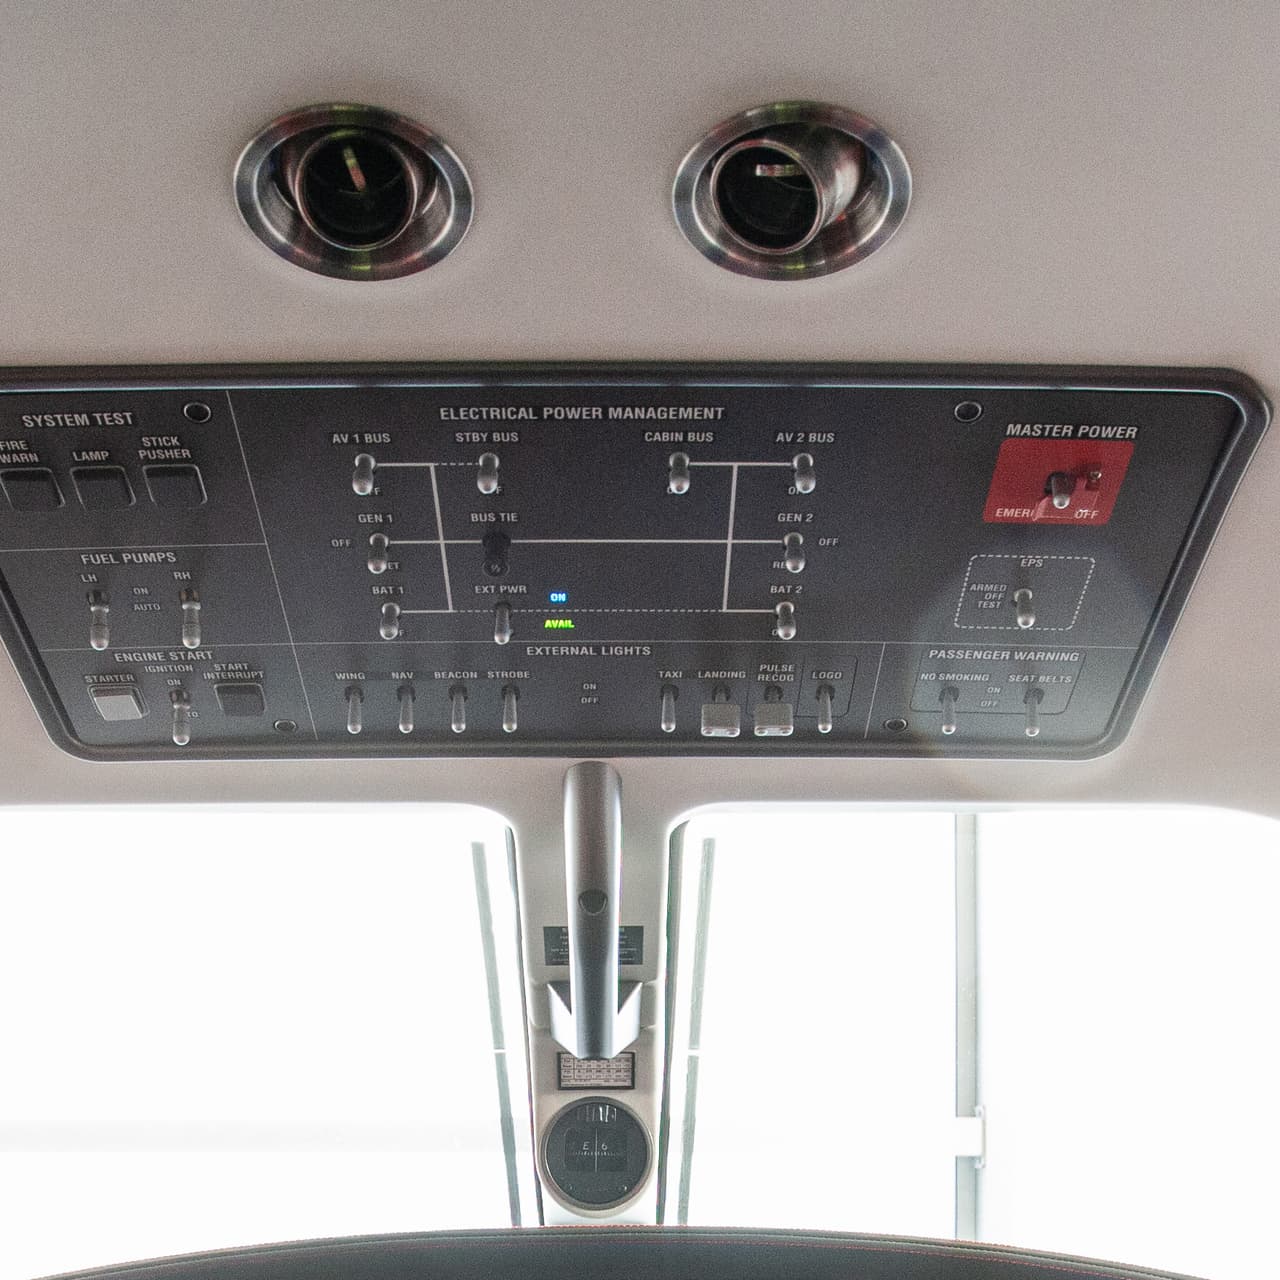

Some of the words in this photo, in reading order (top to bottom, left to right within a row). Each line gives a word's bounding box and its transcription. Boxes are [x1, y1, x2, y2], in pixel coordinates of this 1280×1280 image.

[440, 408, 538, 420] ELECTRICAL
[543, 407, 603, 420] POWER
[609, 407, 725, 420] MANAGEMENT
[22, 413, 90, 428] SYSTEM
[93, 412, 133, 425] TEST
[1006, 424, 1073, 437] MASTER
[1078, 425, 1138, 439] POWER
[332, 434, 352, 444] AV
[354, 434, 360, 443] 1
[365, 434, 391, 443] BUS
[455, 433, 488, 442] STBY
[492, 432, 519, 442] BUS
[644, 432, 684, 442] CABIN
[687, 432, 714, 442] BUS
[776, 433, 794, 443] AV
[797, 433, 805, 442] 2
[809, 433, 835, 443] BUS
[142, 437, 180, 447] STICK
[73, 451, 110, 462] LAMP
[139, 449, 192, 460] PUSHER
[358, 514, 384, 524] GEN
[387, 514, 393, 523] 1
[471, 513, 497, 523] BUS
[499, 513, 519, 522] TIE
[778, 514, 802, 522] GEN
[805, 514, 814, 522] 2
[1074, 510, 1099, 519] OFF
[332, 539, 351, 548] OFF
[819, 538, 839, 546] OFF
[81, 553, 120, 565] FUEL
[122, 552, 177, 563] PUMPS
[1021, 559, 1043, 568] EPS
[81, 574, 97, 583] LH
[174, 572, 191, 580] RH
[133, 587, 149, 595] ON
[372, 586, 395, 595] BAT
[398, 586, 404, 595] 1
[475, 585, 495, 594] EXT
[500, 585, 527, 594] PWR
[770, 586, 792, 594] BAT
[795, 586, 803, 594] 2
[970, 584, 1007, 592] ARMED
[550, 593, 566, 603] ON
[544, 620, 575, 629] AVAIL
[527, 647, 597, 656] EXTERNAL
[601, 646, 651, 655] LIGHTS
[115, 652, 166, 662] ENGINE
[170, 651, 214, 661] START
[929, 650, 1010, 660] PASSENGER
[1014, 652, 1080, 662] WARNING
[145, 665, 194, 673] IGNITION
[214, 663, 249, 671] START
[760, 664, 795, 672] PULSE
[84, 675, 135, 683] STARTER
[204, 671, 265, 680] INTERRUPT
[336, 672, 365, 681] WING
[391, 672, 414, 680] NAV
[434, 671, 478, 679] BEACON
[488, 671, 530, 679] STROBE
[698, 671, 746, 679] LANDING
[758, 674, 794, 682] RECOG
[812, 672, 842, 680] LOGO
[920, 673, 936, 681] NO
[938, 673, 990, 681] SMOKING
[1009, 675, 1035, 683] SEAT
